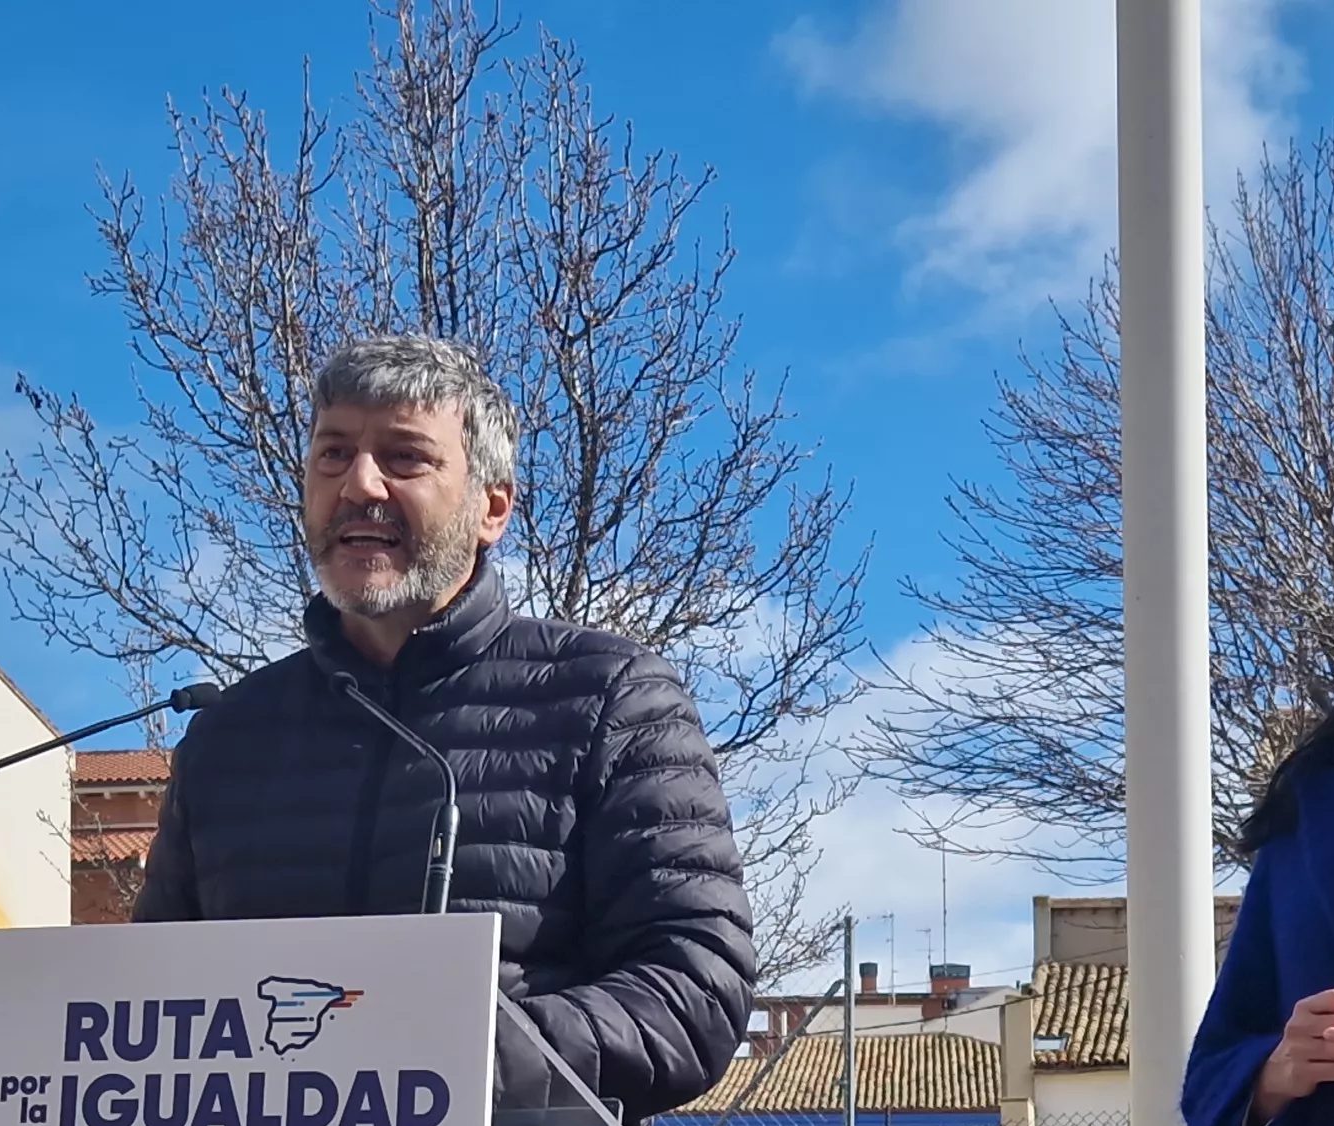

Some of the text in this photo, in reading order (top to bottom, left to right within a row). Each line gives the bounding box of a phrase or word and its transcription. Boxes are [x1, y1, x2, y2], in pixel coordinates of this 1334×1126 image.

[63, 998, 254, 1062] RUTA
[0, 1075, 52, 1103] por
[19, 1096, 48, 1124] la
